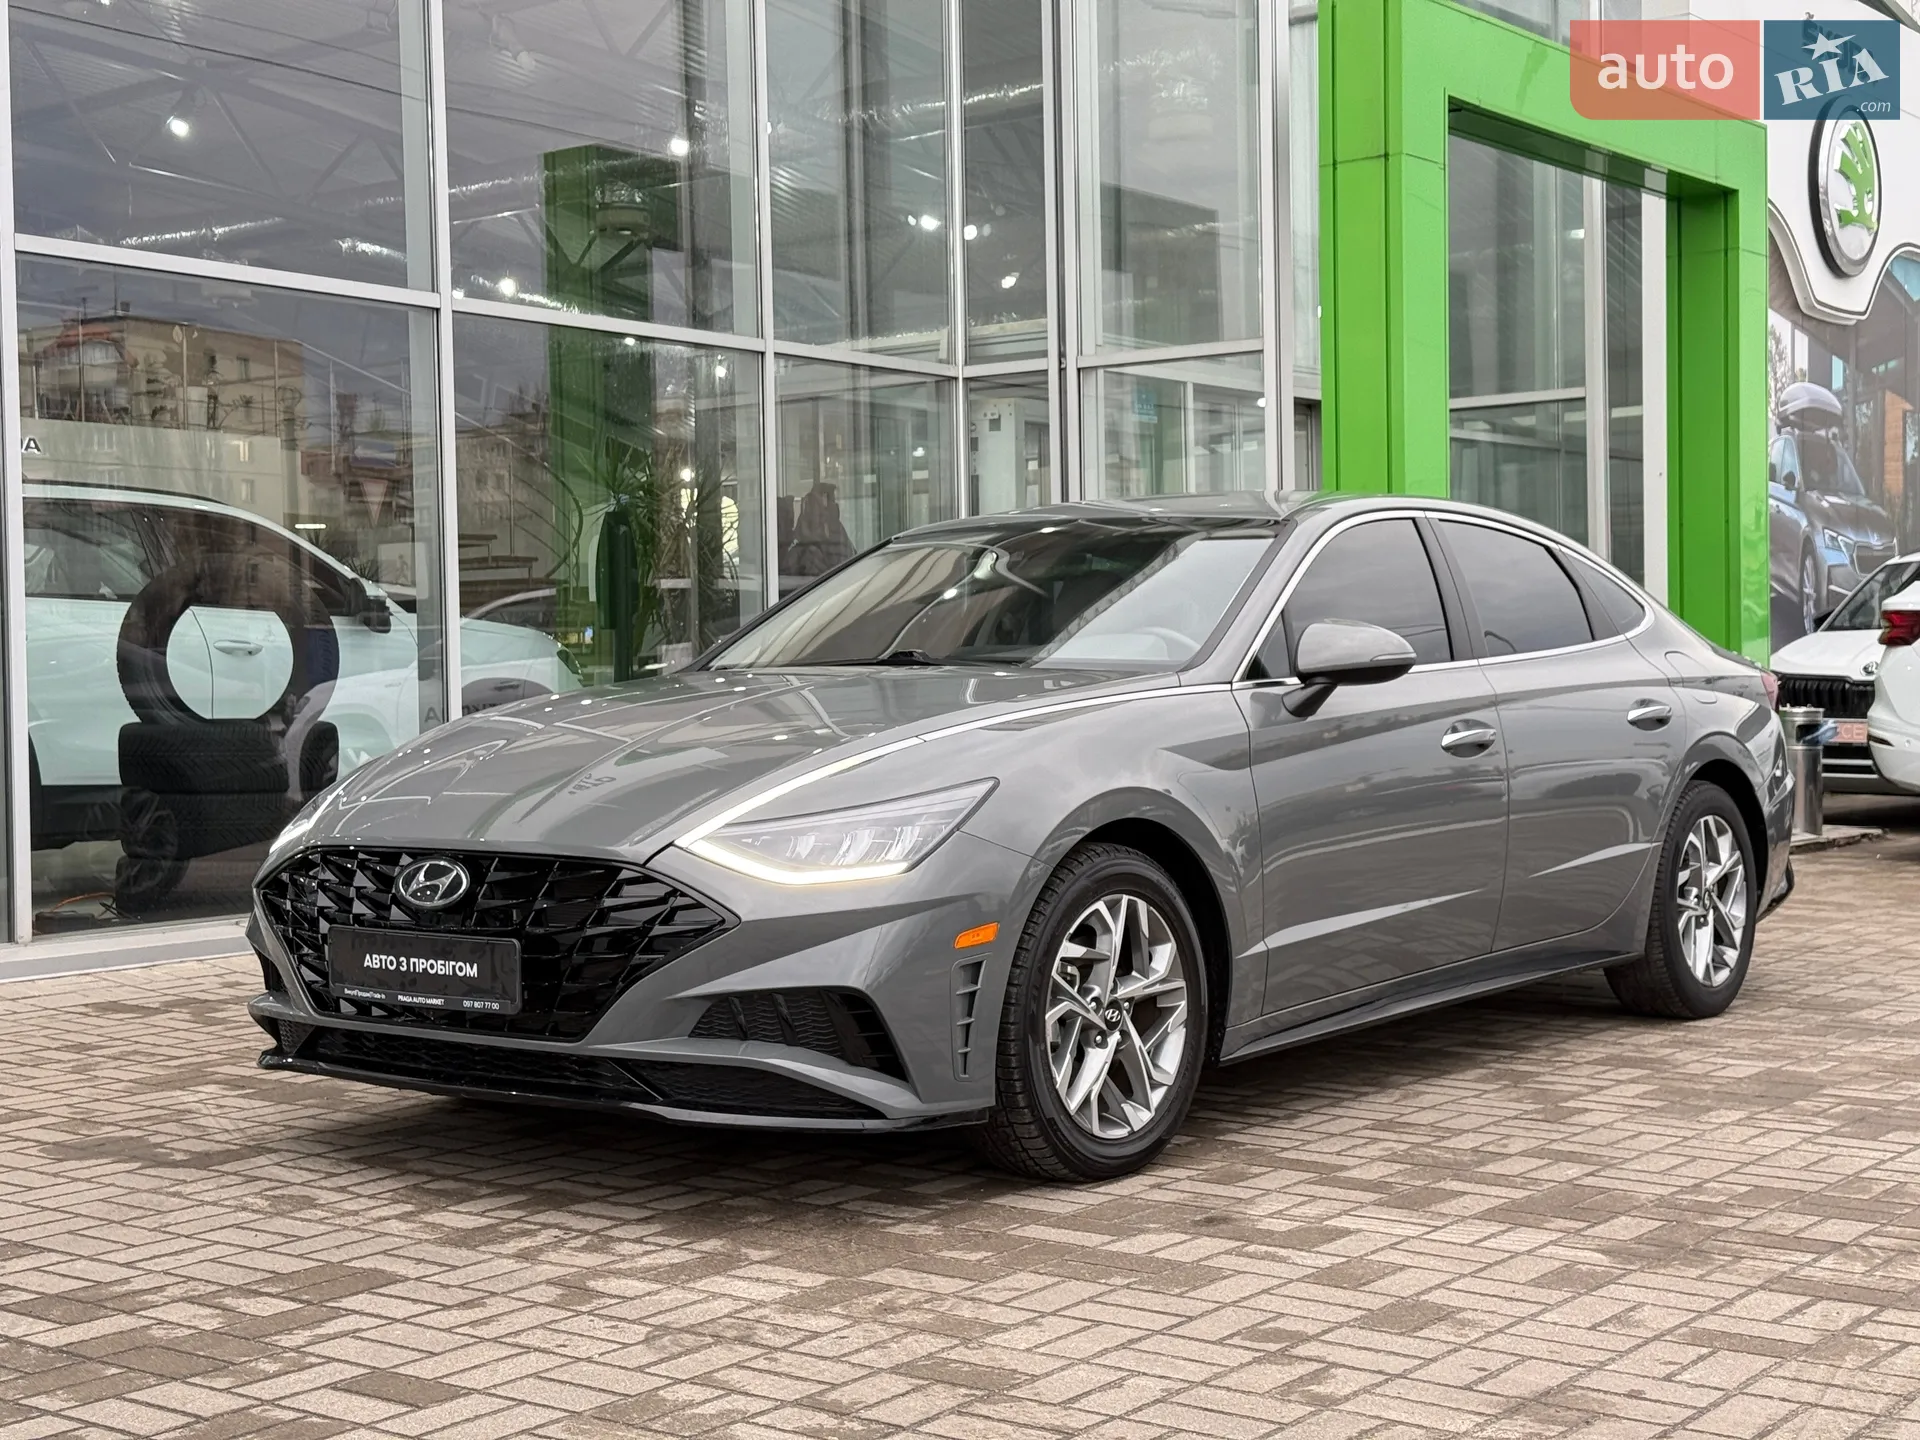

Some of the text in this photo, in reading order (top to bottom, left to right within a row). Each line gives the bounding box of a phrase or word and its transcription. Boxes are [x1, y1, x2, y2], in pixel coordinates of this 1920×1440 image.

[363, 953, 478, 978] АВТО З ПРОБІГОМ
[413, 996, 426, 1004] AUTO
[426, 998, 445, 1006] MARKET
[463, 1000, 473, 1008] 097
[491, 1002, 500, 1010] 00
